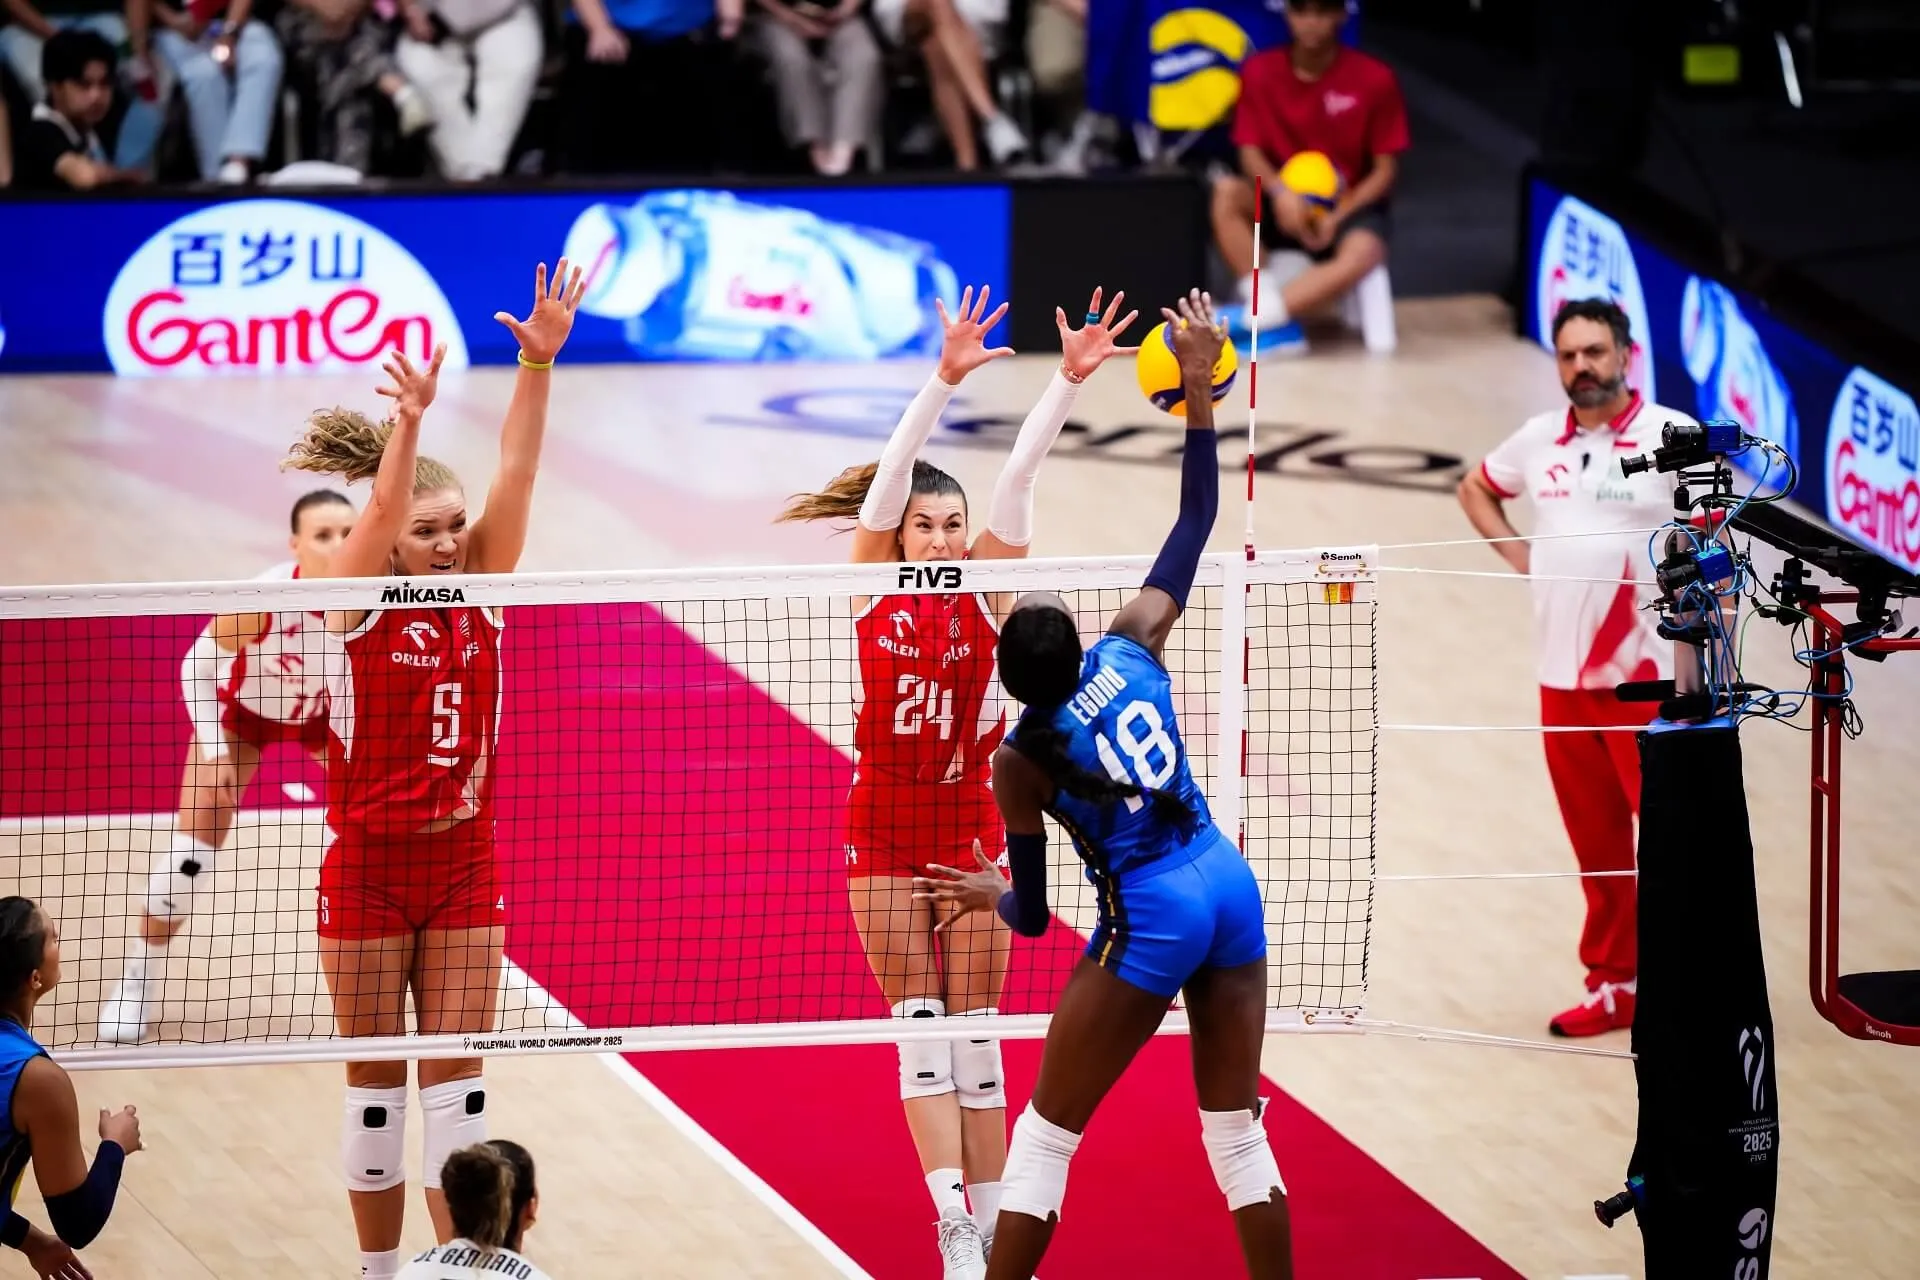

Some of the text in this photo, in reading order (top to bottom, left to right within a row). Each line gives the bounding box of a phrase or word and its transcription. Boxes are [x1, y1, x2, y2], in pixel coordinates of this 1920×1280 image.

[171, 229, 364, 286] 百岁山
[762, 387, 1464, 476] Gerflo
[1330, 552, 1362, 561] Senoh
[899, 566, 962, 589] FIVB
[380, 581, 465, 603] MIKASA
[877, 636, 920, 659] ORLEN
[391, 652, 441, 668] ORLEN
[893, 673, 955, 740] 24
[1066, 664, 1128, 727] EGONU
[432, 682, 462, 749] 5
[1095, 699, 1177, 815] 18
[472, 1036, 623, 1050] VOLLEYBALL WORLD CHAMPIONSHIP 2025
[1743, 1130, 1772, 1153] 2025
